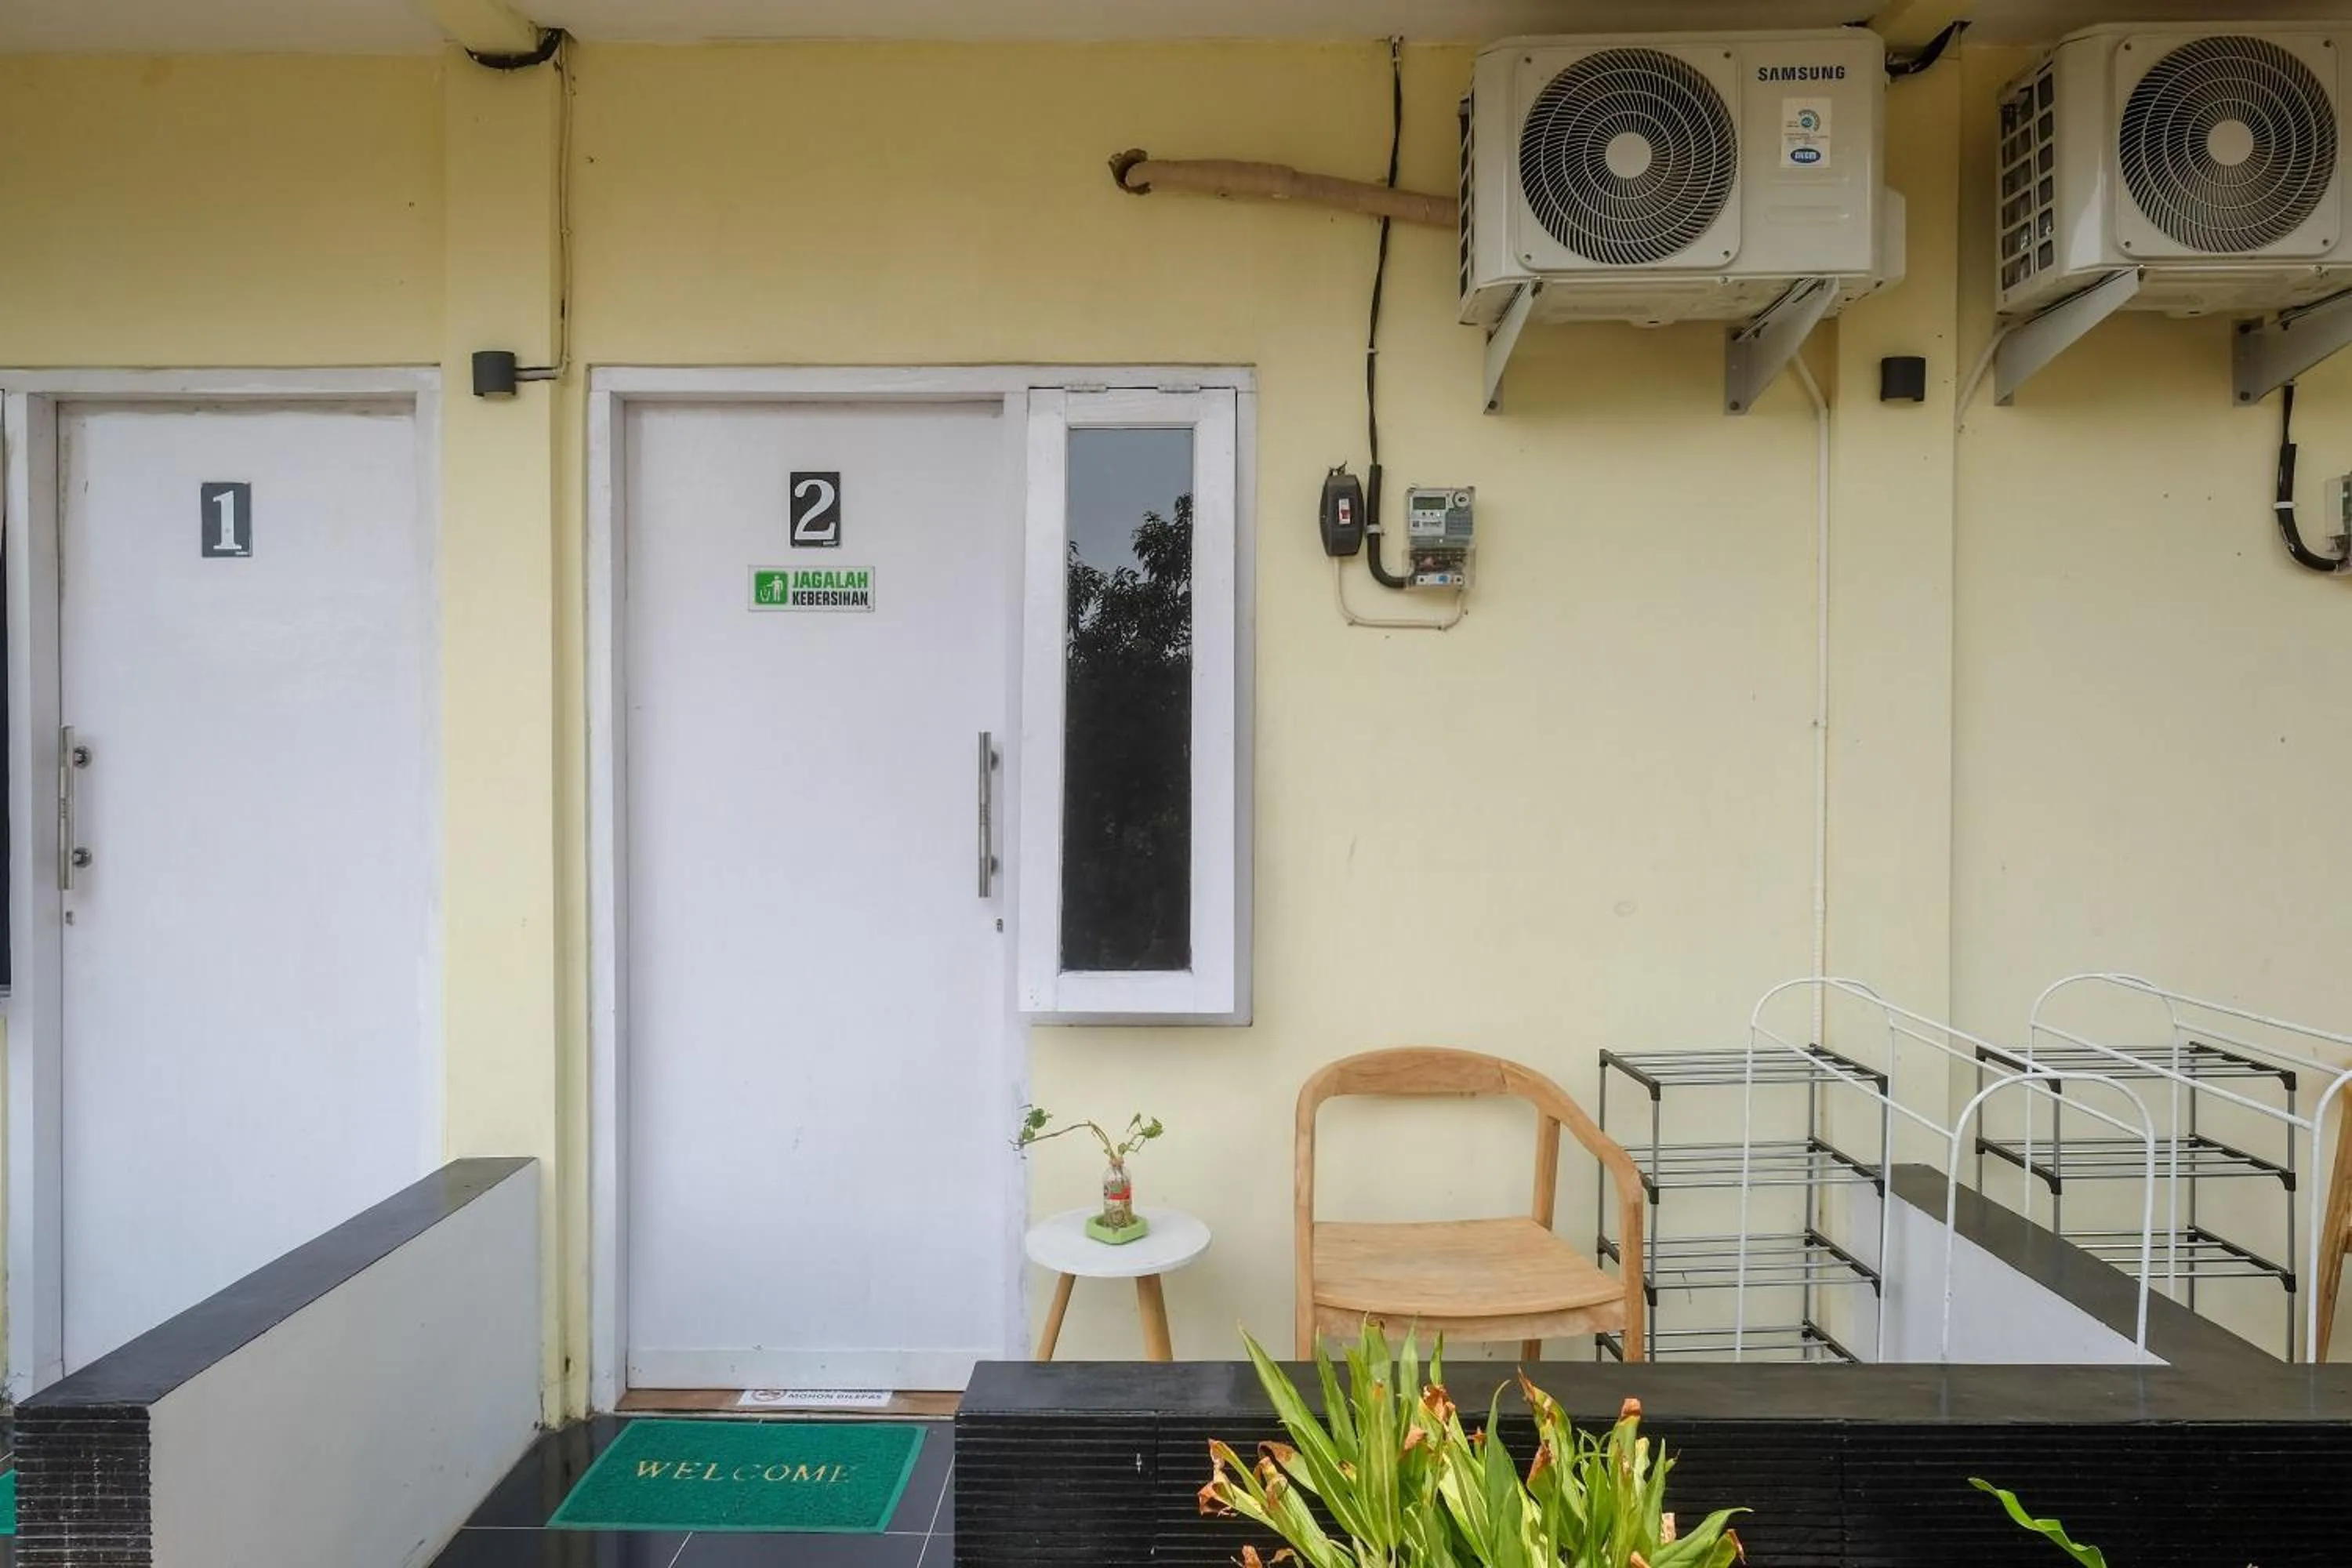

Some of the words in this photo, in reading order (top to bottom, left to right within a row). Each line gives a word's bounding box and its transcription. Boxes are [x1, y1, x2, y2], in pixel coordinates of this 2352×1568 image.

[1758, 66, 1845, 82] SAMSUNG
[794, 479, 837, 540] 2
[212, 490, 242, 550] 1
[793, 571, 868, 589] JAGALAH
[793, 590, 869, 605] KEBERSIHAN
[636, 1461, 856, 1483] WELCOME
